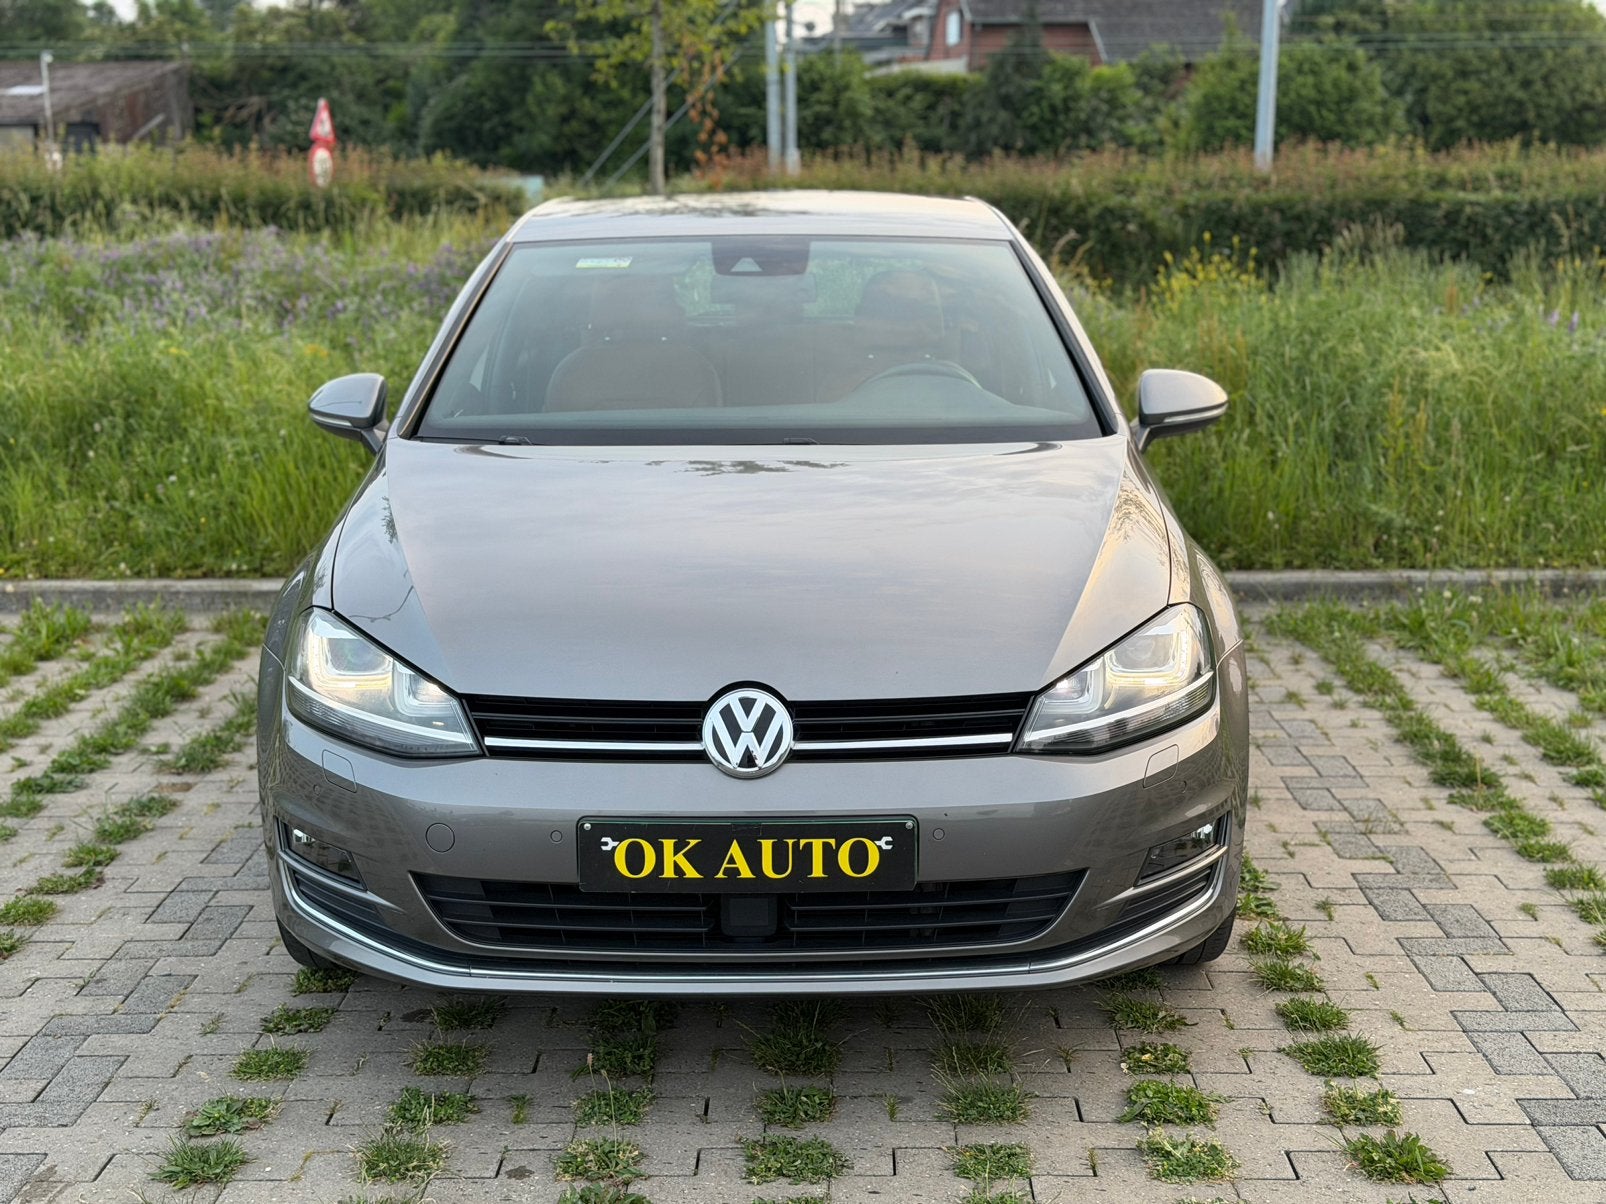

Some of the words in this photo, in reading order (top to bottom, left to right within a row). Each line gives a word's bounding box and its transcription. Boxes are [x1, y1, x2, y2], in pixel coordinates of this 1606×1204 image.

[708, 694, 786, 772] VW
[614, 838, 704, 879] OK
[714, 837, 880, 879] AUTO
